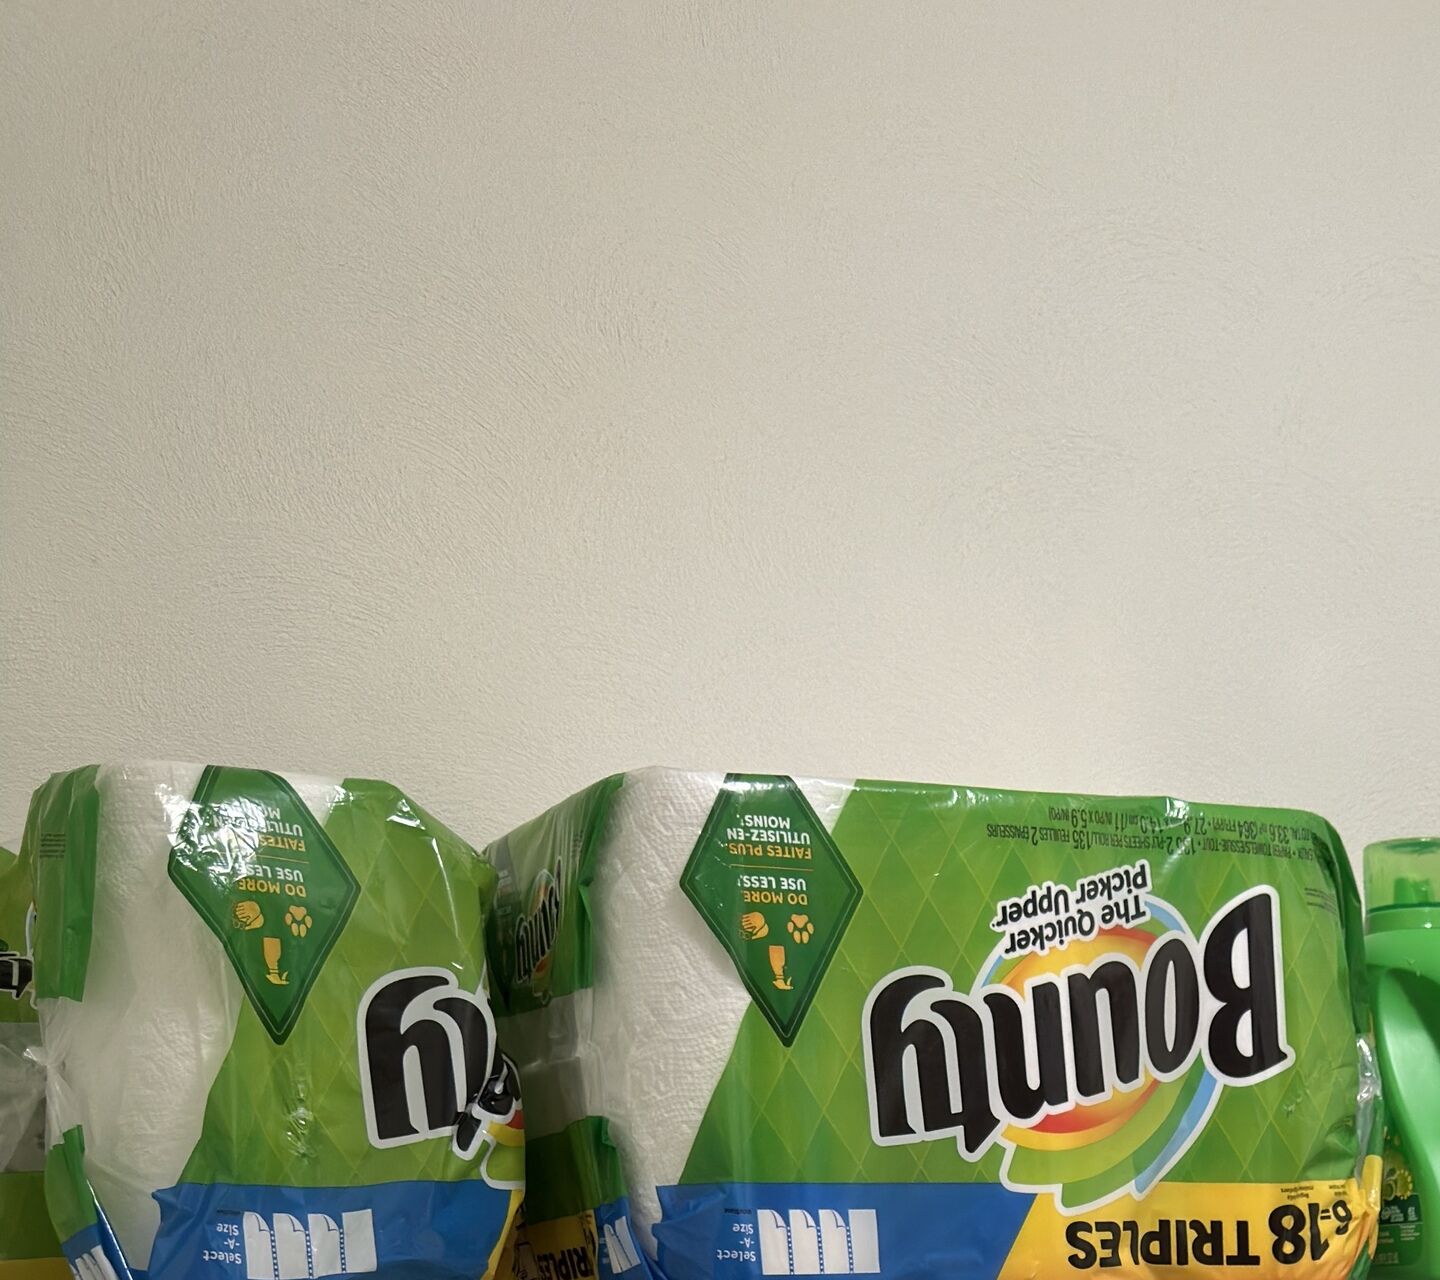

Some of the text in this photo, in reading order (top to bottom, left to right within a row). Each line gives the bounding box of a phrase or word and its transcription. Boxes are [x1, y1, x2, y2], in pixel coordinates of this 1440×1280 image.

[726, 827, 811, 845] UTILISEZ-EN
[1031, 826, 1038, 846] 2
[766, 844, 812, 860] FAITES
[277, 867, 304, 883] USE
[238, 878, 307, 898] DO MORE
[780, 876, 807, 891] USE
[743, 890, 808, 906] DO MORE
[995, 863, 1149, 928] Picker Upper
[1004, 894, 1148, 955] The Quicker
[868, 890, 1289, 1155] Bounty
[216, 1223, 240, 1237] Size
[732, 1223, 754, 1236] Size
[1064, 1219, 1262, 1271] TRIPLES
[202, 1249, 243, 1265] Select
[716, 1249, 757, 1262] Select
